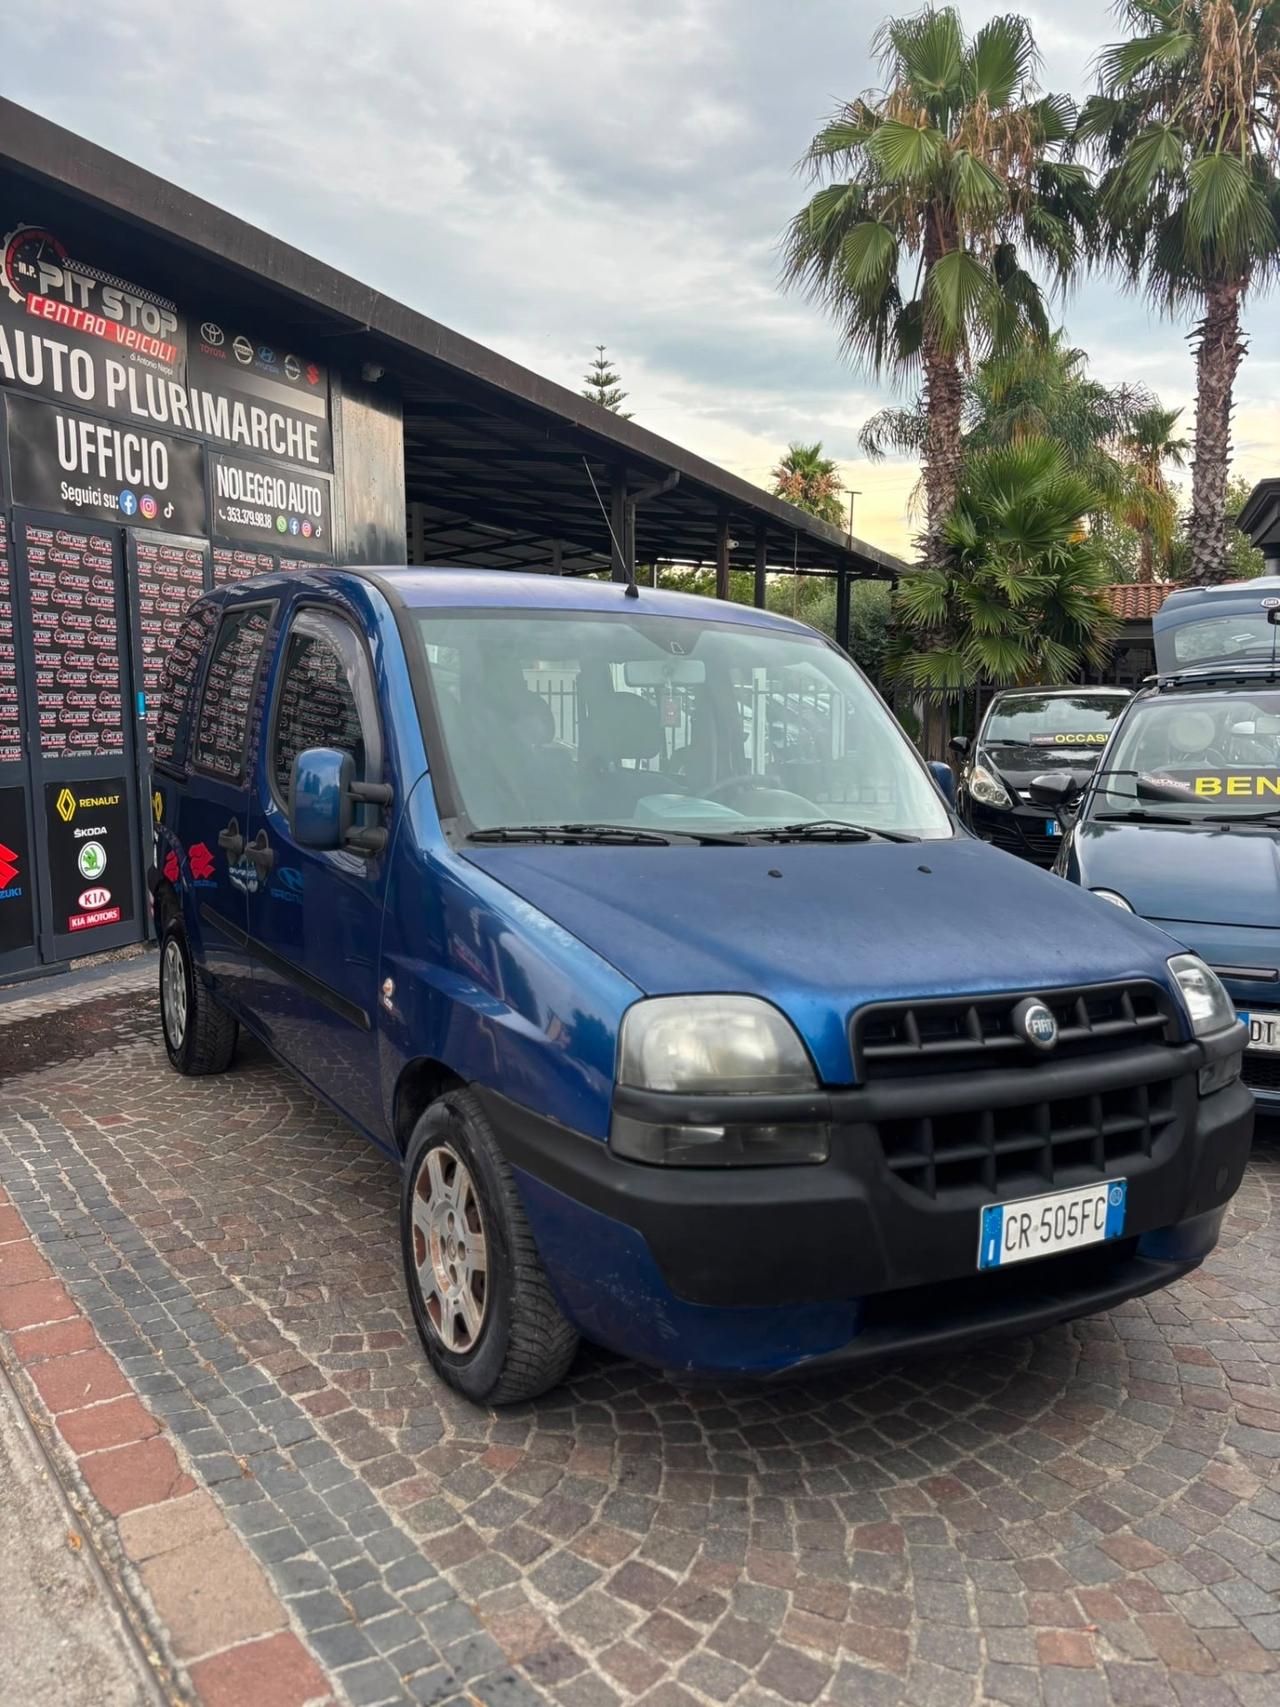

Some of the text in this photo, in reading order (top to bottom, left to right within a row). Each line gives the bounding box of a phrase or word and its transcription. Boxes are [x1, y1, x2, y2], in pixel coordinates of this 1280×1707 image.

[37, 260, 178, 339] PIT STOP
[199, 343, 227, 359] TOYOTA
[106, 359, 320, 463] PLURIMARCHE
[56, 415, 169, 491] UFFICIO
[61, 482, 119, 510] Seguici su:
[216, 464, 322, 517] NOLEGGIO AUTO
[79, 795, 120, 808] RENAULT
[73, 826, 108, 839] ŠKODA
[85, 891, 106, 905] KIA
[71, 910, 118, 928] KIA MOTORS
[1032, 1018, 1055, 1034] FIAT
[1251, 1020, 1276, 1044] DT
[1005, 1212, 1033, 1252] CR
[1039, 1195, 1106, 1244] 505FC
